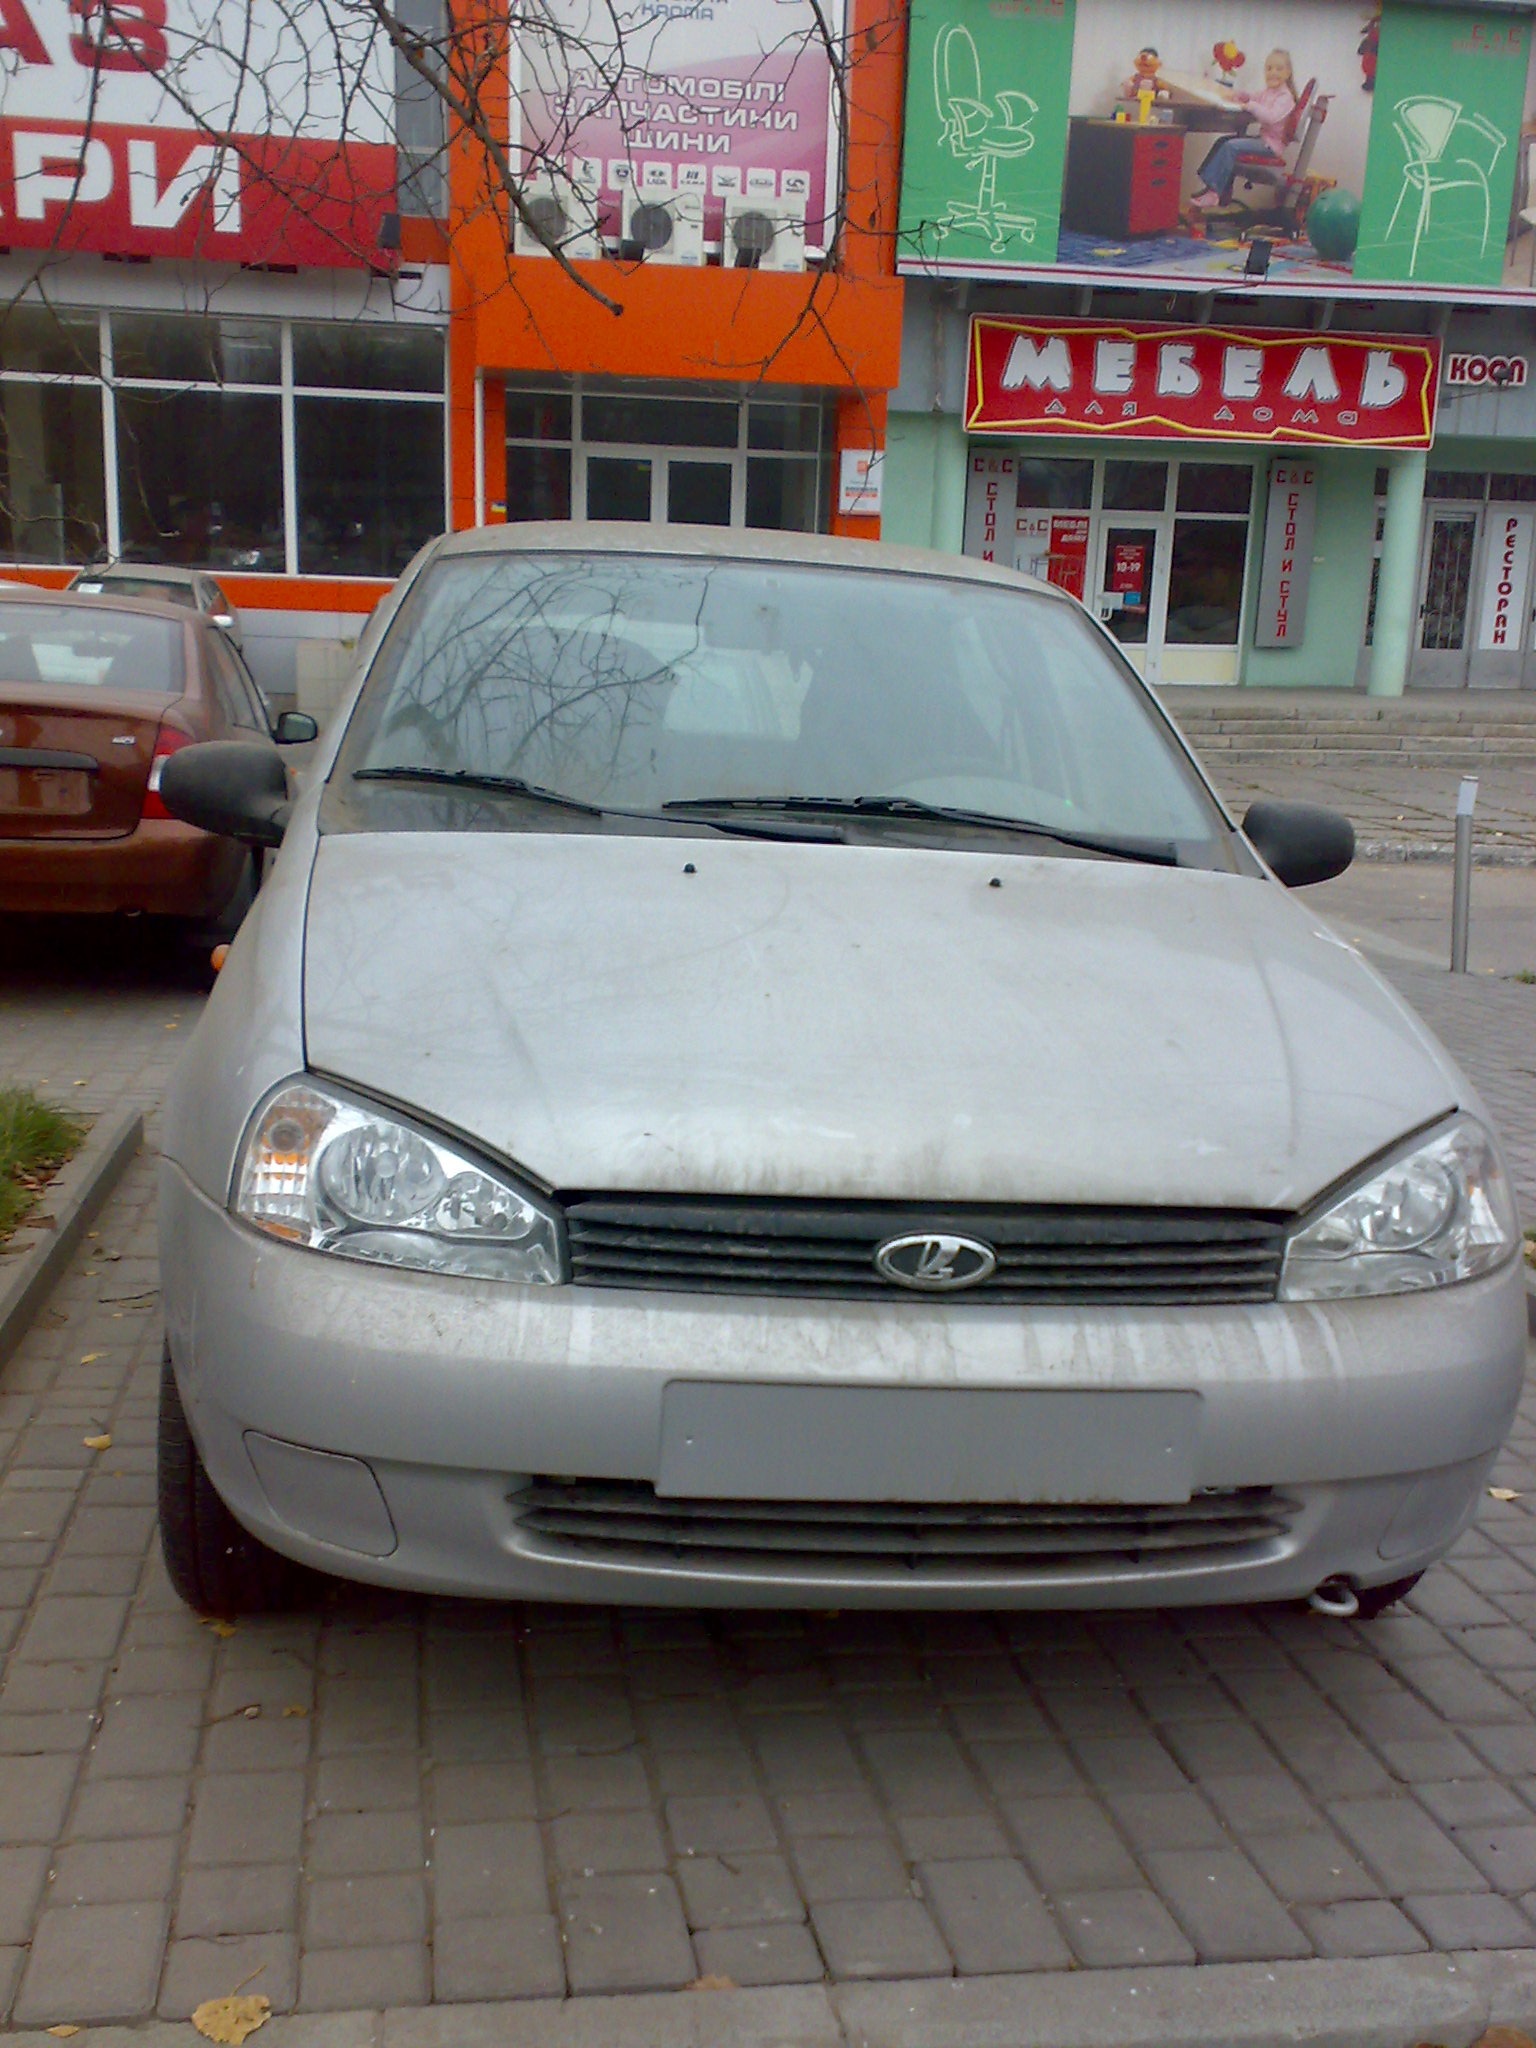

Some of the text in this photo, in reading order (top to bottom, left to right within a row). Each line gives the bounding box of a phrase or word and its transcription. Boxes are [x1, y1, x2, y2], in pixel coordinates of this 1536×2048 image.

[554, 97, 798, 130] ЗАПЧАСТИНИ
[571, 68, 785, 102] АВТОМОБІЛІ
[622, 128, 730, 154] ШИНИ
[0, 130, 241, 233] РИ
[1002, 334, 1407, 408] МЕБЕЛЬ
[984, 482, 998, 541] СТОЛ
[1276, 493, 1299, 637] СТОЛ И СТУЛ
[1493, 517, 1518, 644] РЕСТОРАН
